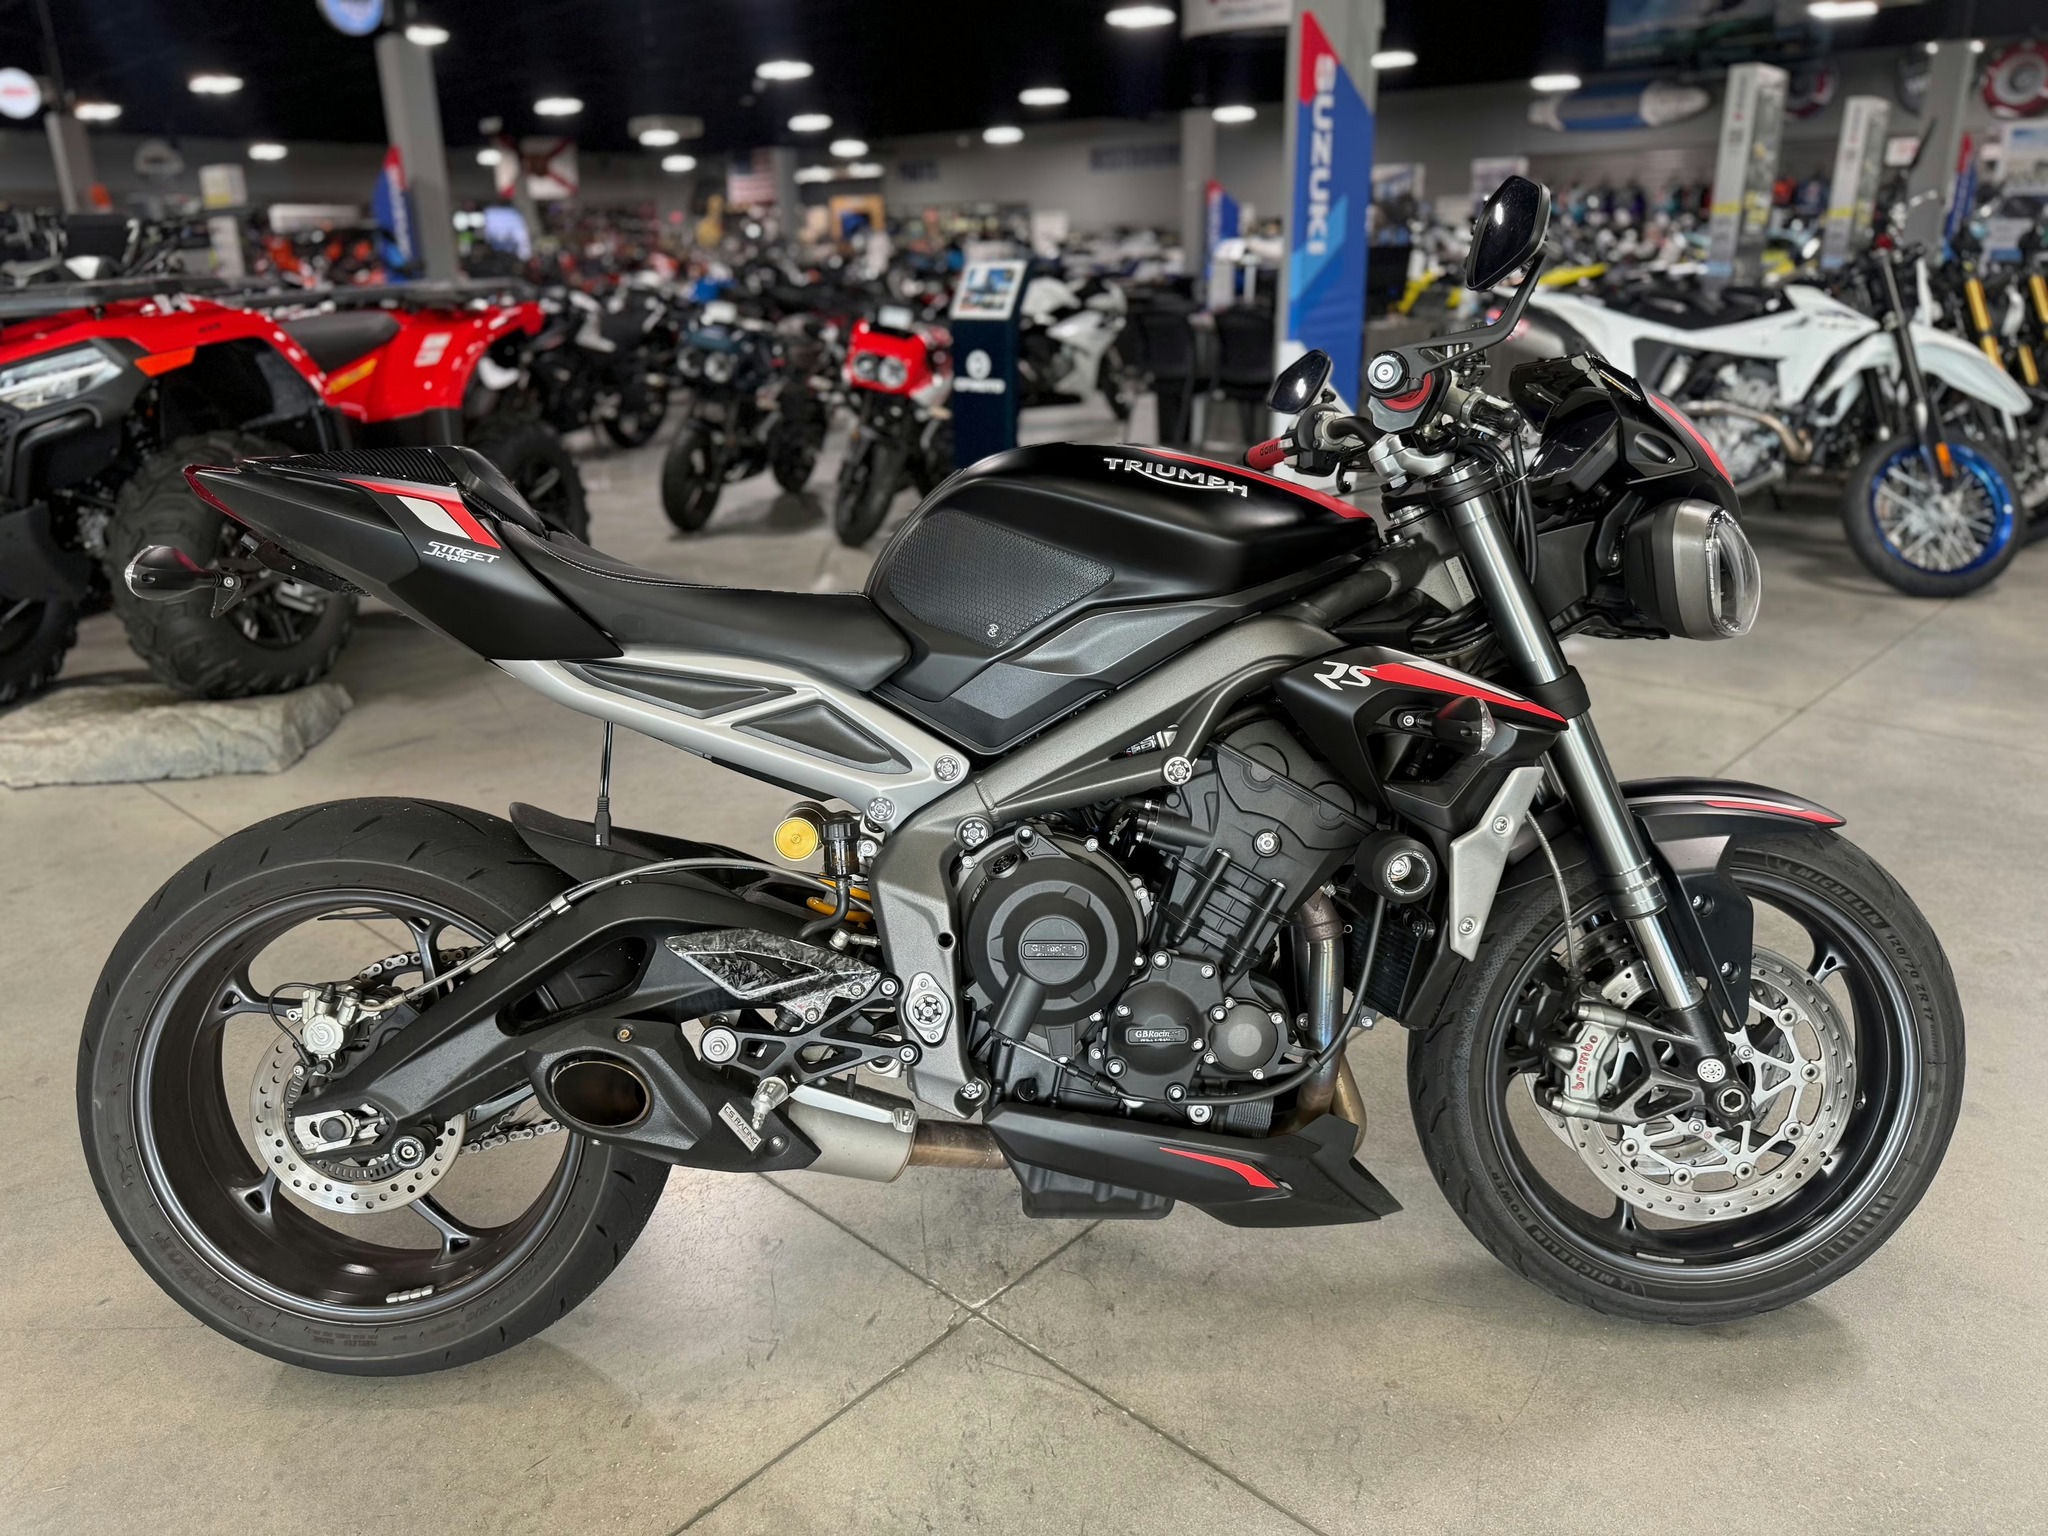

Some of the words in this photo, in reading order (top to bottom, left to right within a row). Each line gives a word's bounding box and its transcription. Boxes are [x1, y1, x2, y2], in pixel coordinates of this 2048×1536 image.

[1305, 53, 1337, 256] SUZUKI
[1103, 457, 1248, 498] TRIUMPH
[423, 541, 500, 564] STREET
[1313, 660, 1378, 691] RS
[1795, 866, 1885, 929] MICHELIN
[1886, 933, 1920, 979] 120/70
[1914, 983, 1930, 1002] ZR
[1922, 1006, 1935, 1022] 17
[1571, 1034, 1599, 1091] brembo
[1491, 1170, 1528, 1223] POWER
[1531, 1227, 1617, 1288] MICHELIN
